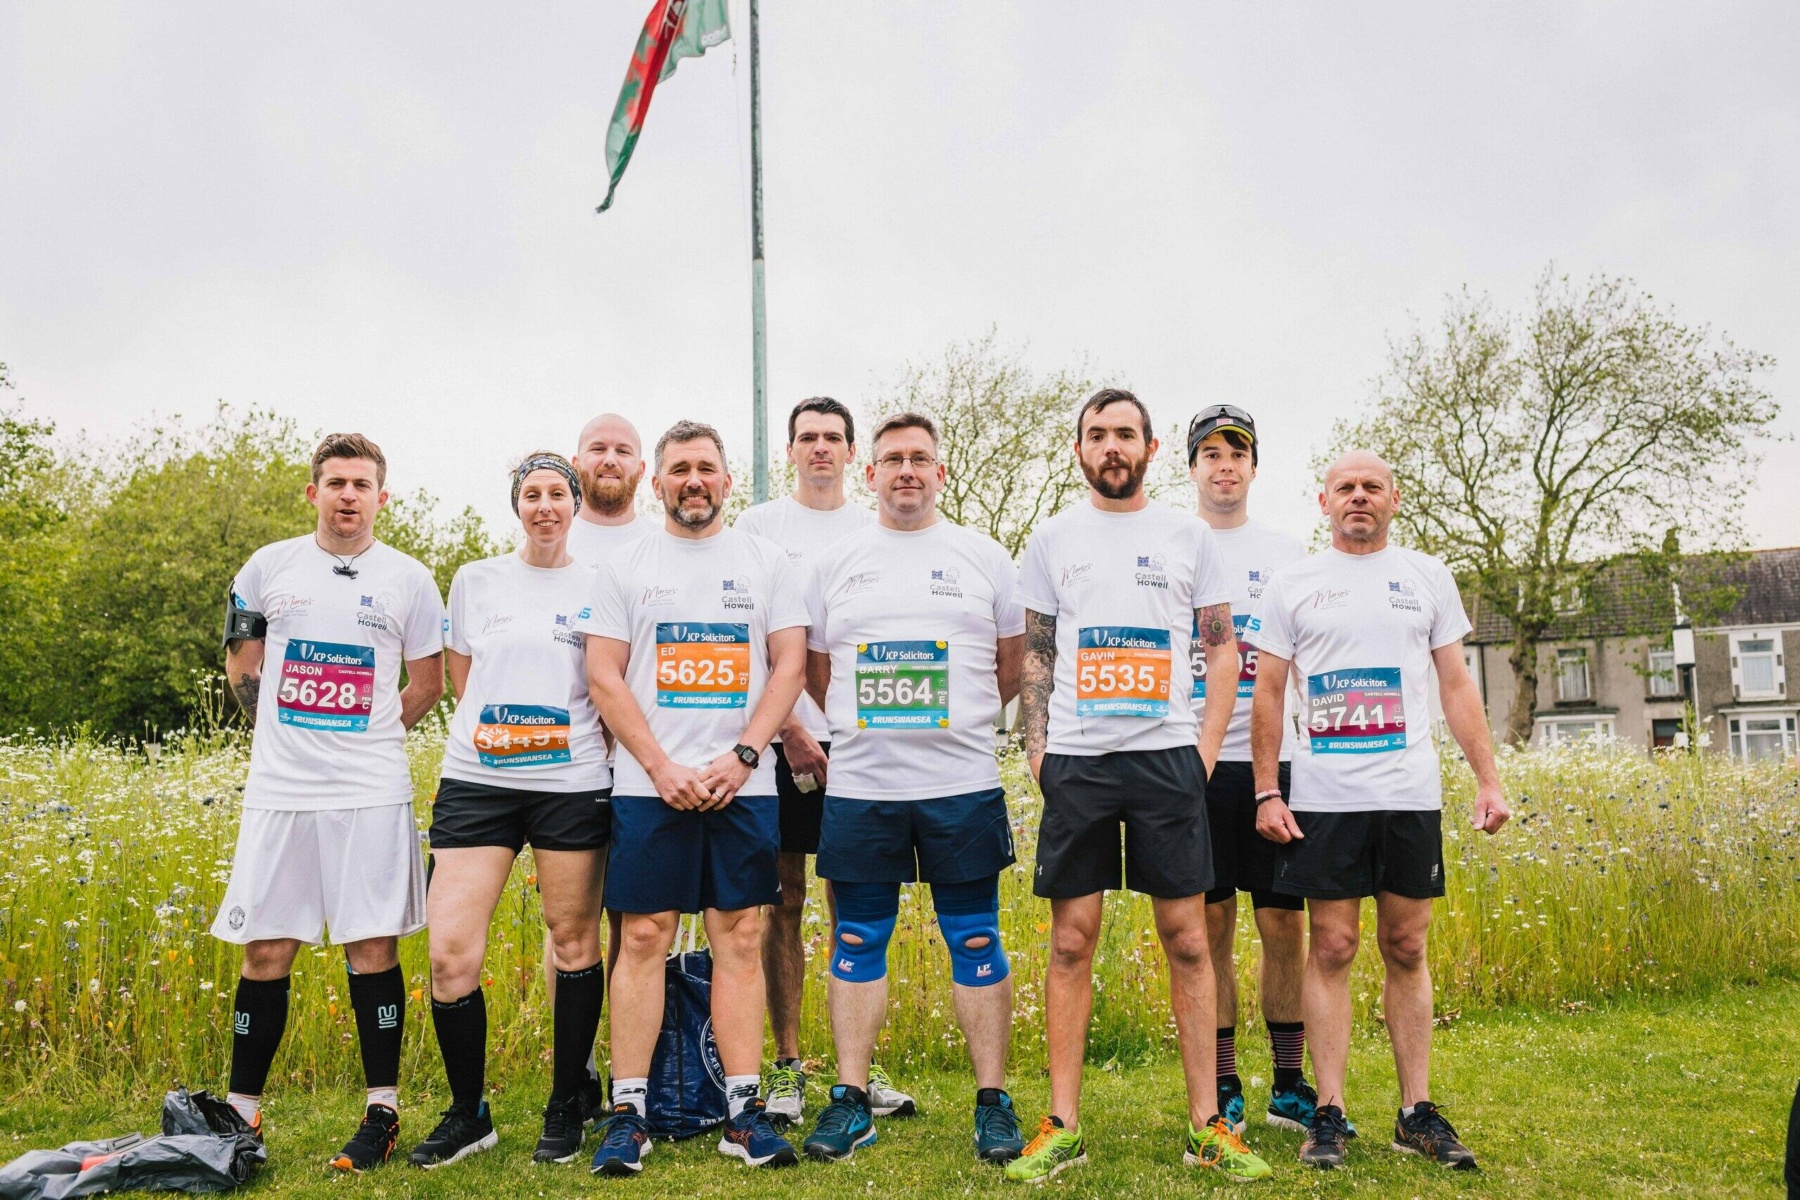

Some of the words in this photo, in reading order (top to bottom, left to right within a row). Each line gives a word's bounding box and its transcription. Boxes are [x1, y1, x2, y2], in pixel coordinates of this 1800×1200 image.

[1135, 572, 1166, 582] Castell
[930, 584, 960, 593] Castell
[1137, 579, 1169, 589] Howell
[932, 590, 963, 598] Howell
[1389, 596, 1419, 605] Castell
[724, 602, 754, 610] Howell
[1392, 603, 1422, 613] Howell
[356, 611, 387, 624] Castell
[358, 619, 387, 631] Howell
[552, 629, 581, 642] Castell
[687, 632, 700, 642] JCP
[701, 633, 736, 642] Solicitors
[553, 635, 582, 649] Howell
[1107, 637, 1121, 647] JCP
[1121, 637, 1157, 649] Solicitors
[661, 646, 676, 656] ED
[885, 651, 898, 660] JCP
[899, 650, 934, 660] Solicitors
[312, 652, 326, 662] JCP
[327, 653, 362, 665] Solicitors
[1081, 652, 1115, 661] GAVIN
[285, 664, 323, 676] JASON
[660, 659, 735, 686] 5625
[859, 664, 898, 674] BARRY
[740, 677, 747, 685] D
[1080, 664, 1155, 692] 5535
[1336, 679, 1350, 689] JCP
[1351, 678, 1387, 687] Solicitors
[279, 677, 356, 709] 5628
[859, 677, 933, 705] 5564
[1160, 685, 1167, 693] D
[673, 696, 732, 704] #RUNSWANSEA
[939, 696, 946, 704] E
[1312, 693, 1345, 707] DAVID
[362, 702, 370, 710] C
[1093, 702, 1152, 711] #RUNSWANSEA
[293, 715, 352, 728] #RUNSWANSEA
[507, 715, 520, 724] JCP
[520, 715, 556, 724] Solicitors
[872, 715, 931, 724] #RUNSWANSEA
[1311, 704, 1385, 732] 5741
[1328, 740, 1389, 749] #RUNSWANSEA
[977, 963, 992, 974] LP
